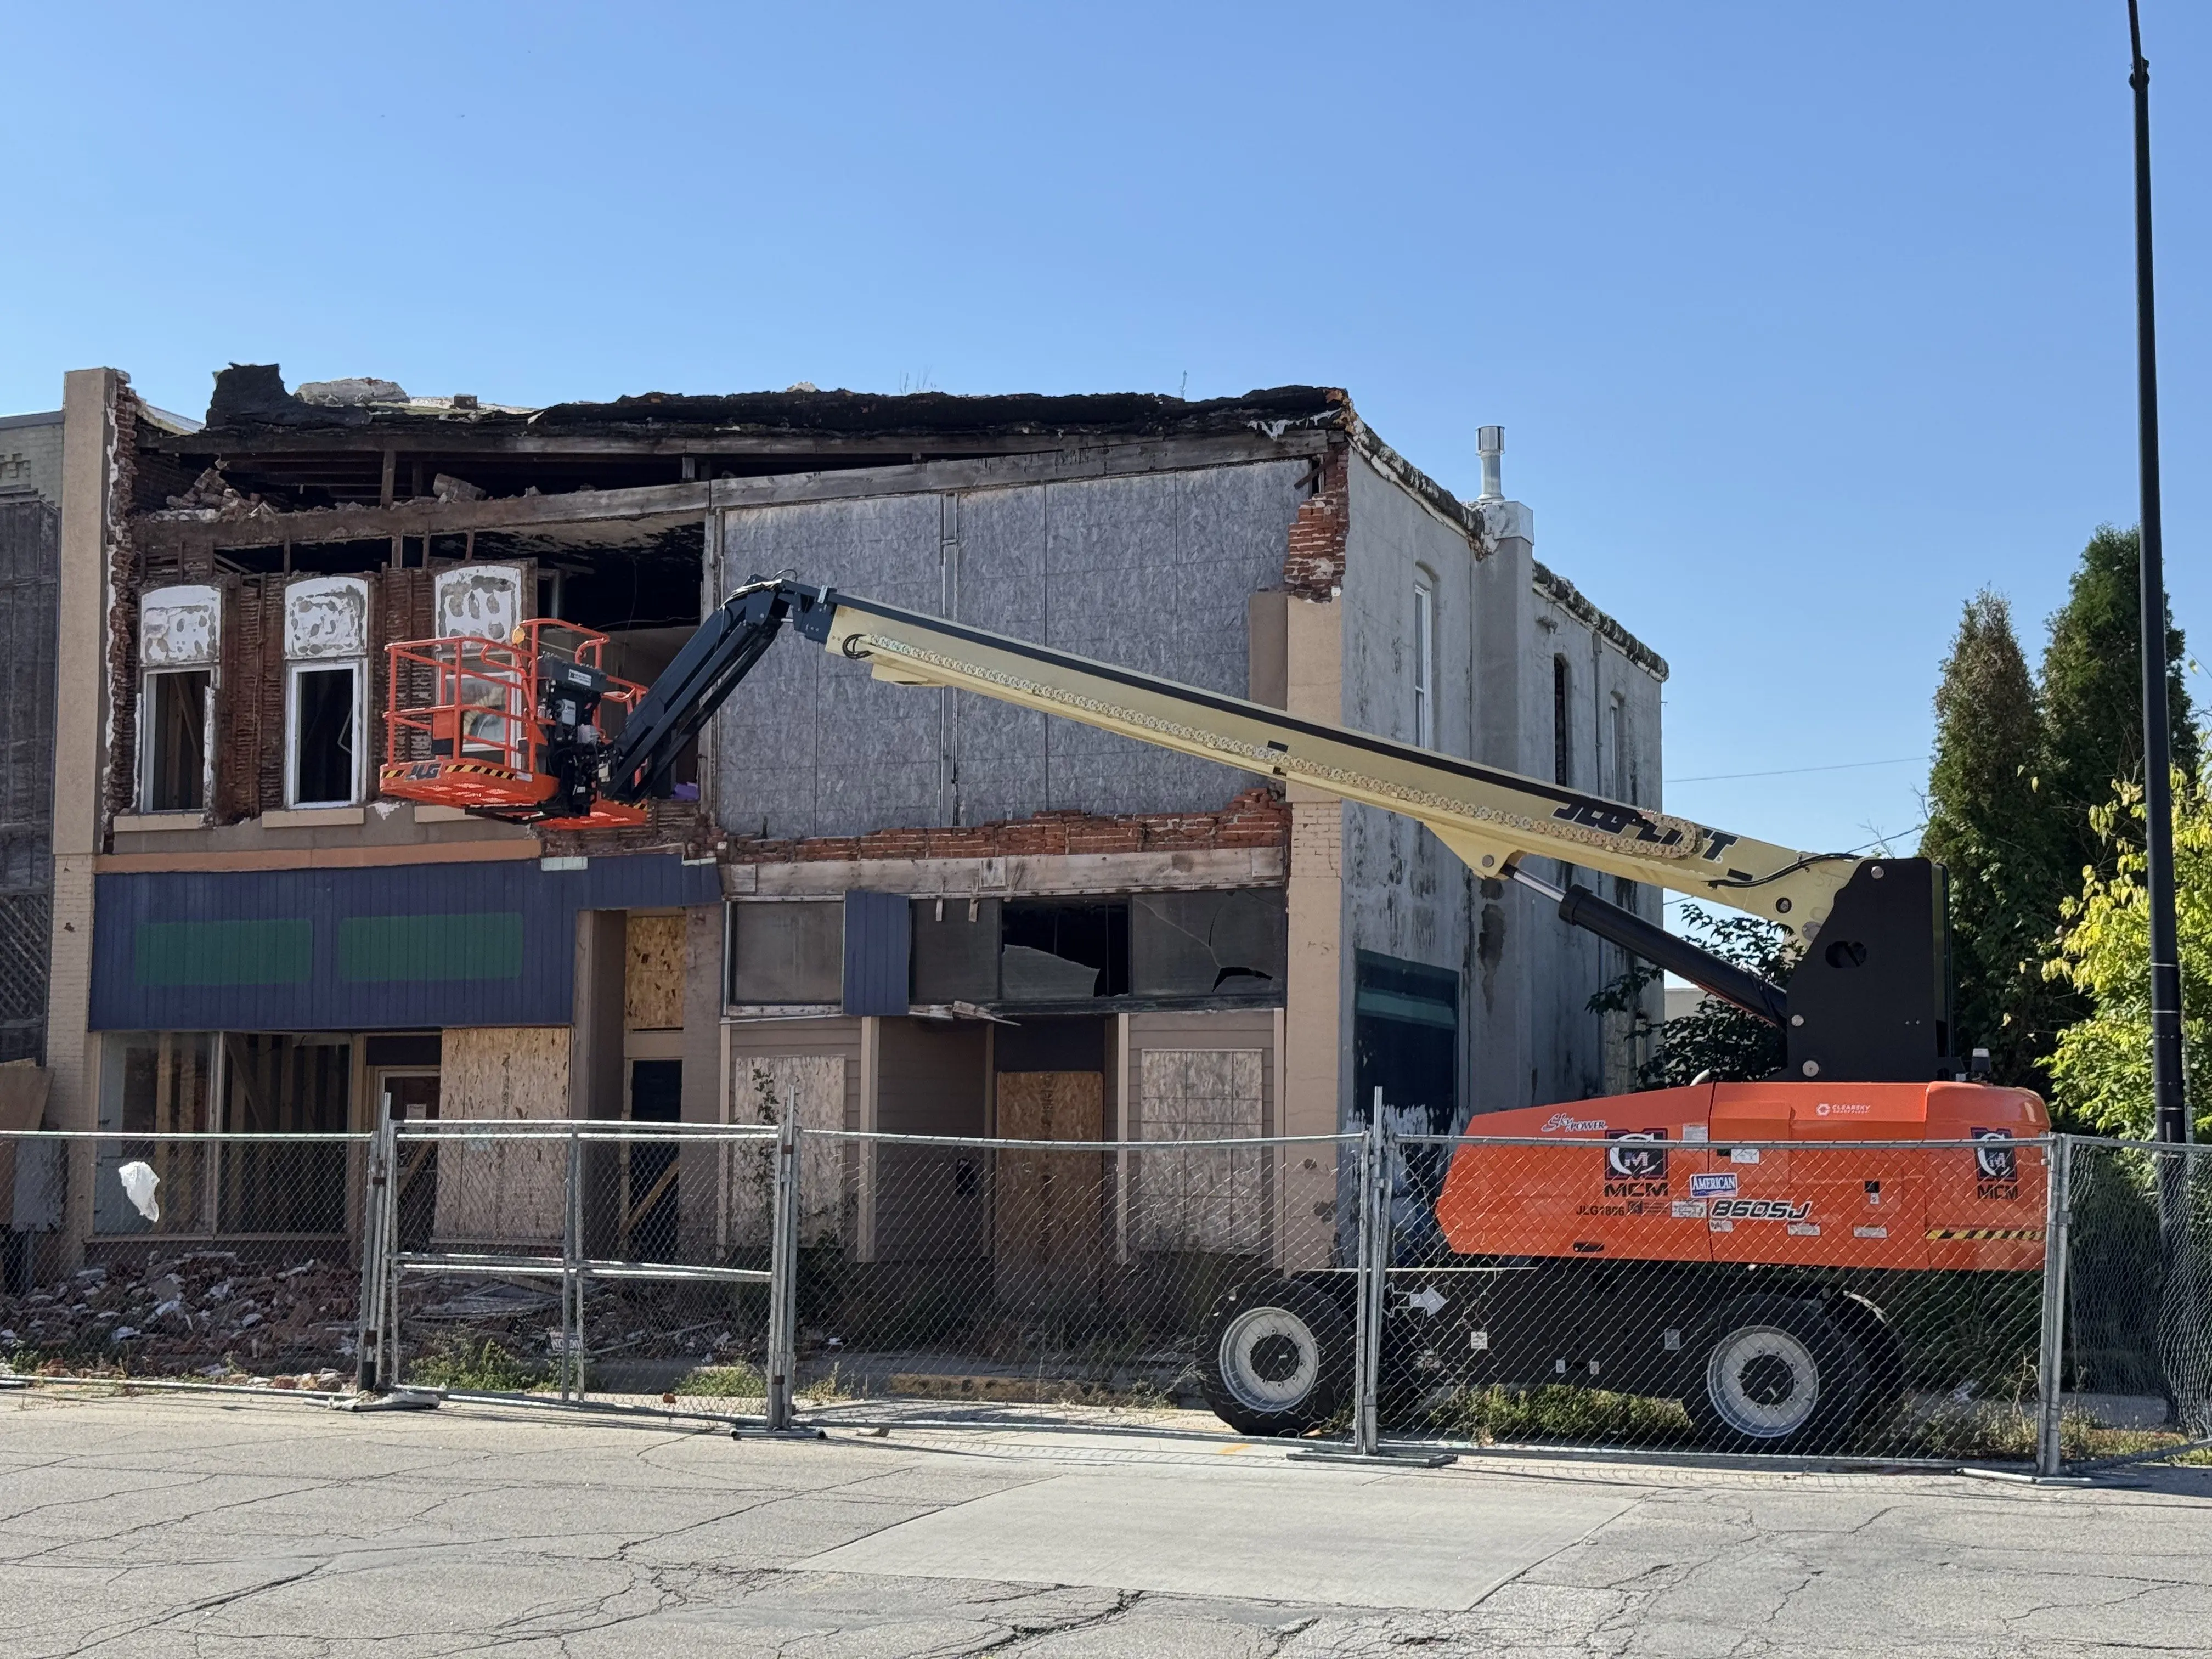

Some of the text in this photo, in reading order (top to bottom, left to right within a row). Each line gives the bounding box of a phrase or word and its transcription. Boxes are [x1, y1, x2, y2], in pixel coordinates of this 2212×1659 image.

[405, 763, 443, 781] JLG
[1604, 1182, 1668, 1197] MCM
[1692, 1176, 1736, 1190] AMERICAN
[1977, 1184, 2018, 1199] MCM
[1711, 1199, 1812, 1221] 860SJ
